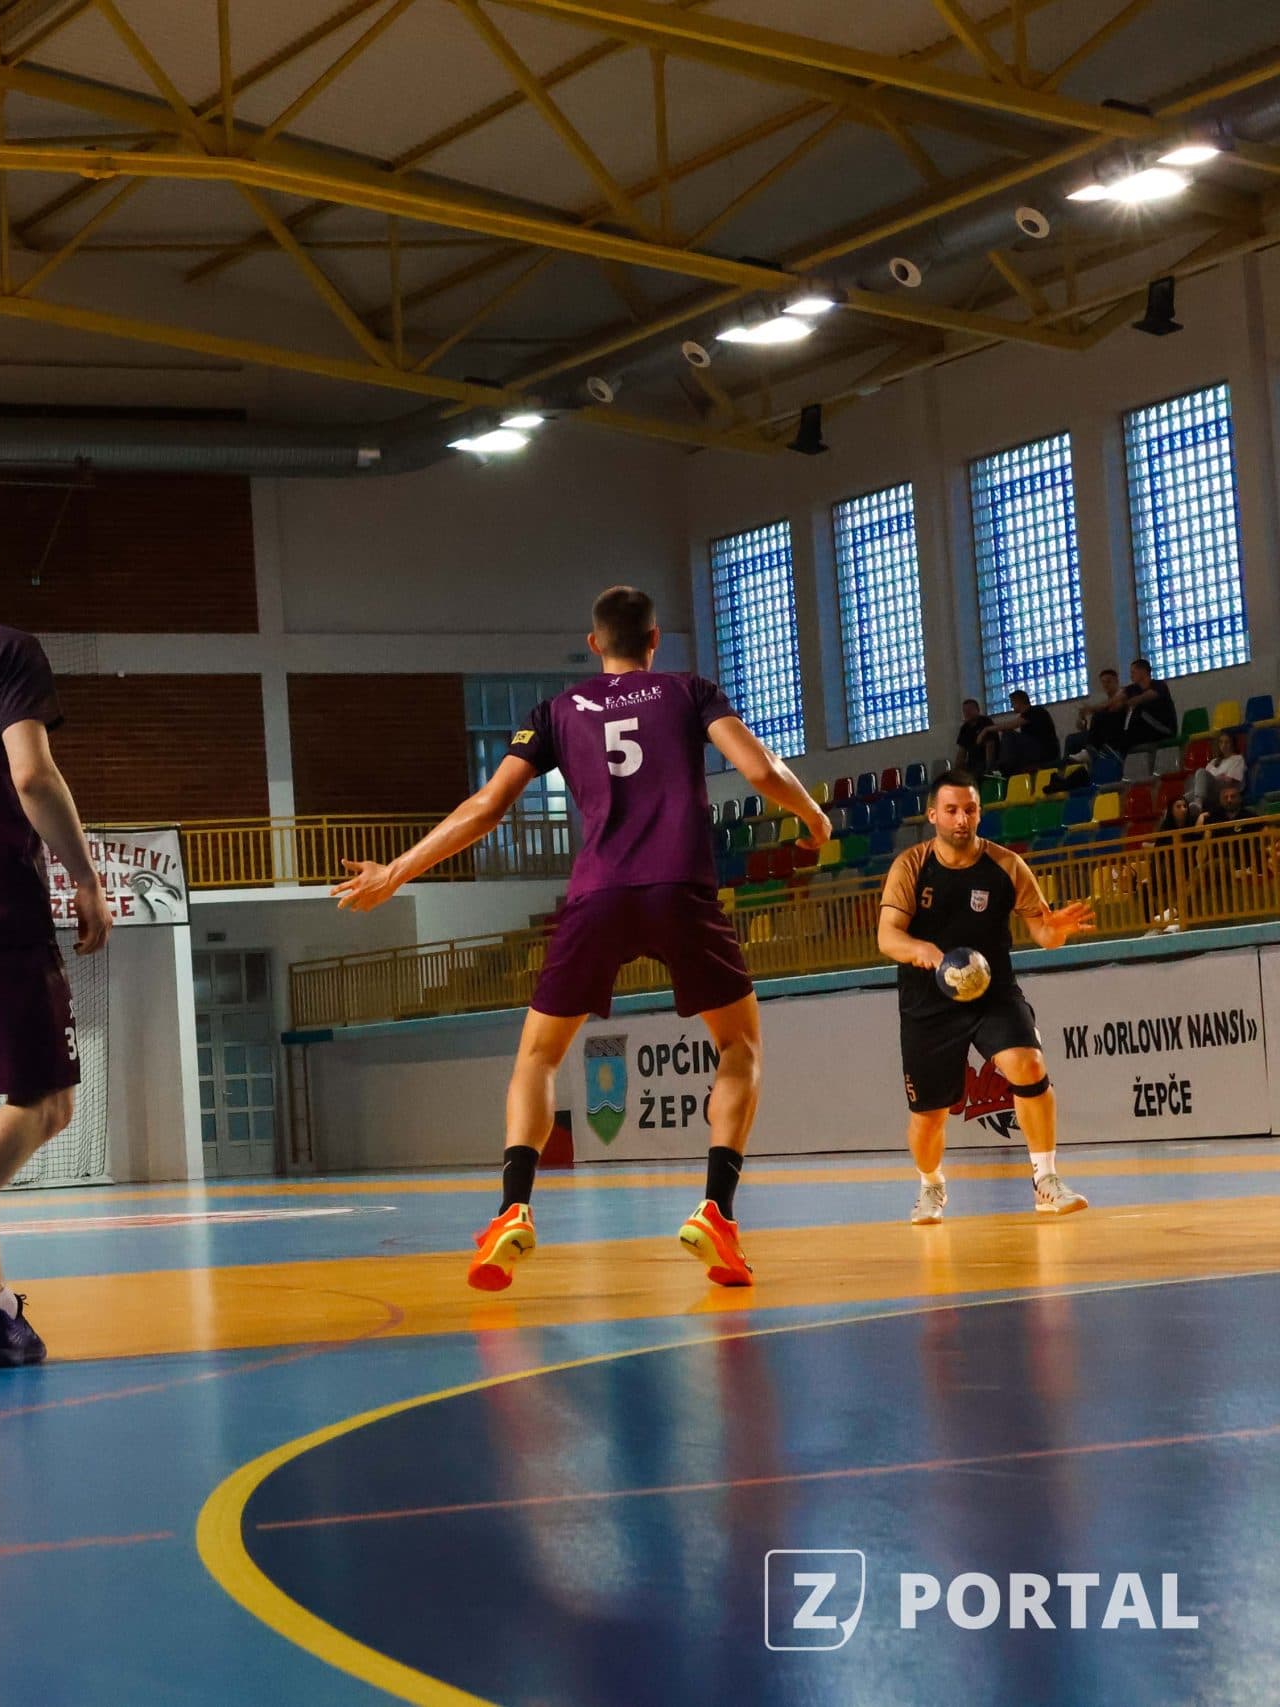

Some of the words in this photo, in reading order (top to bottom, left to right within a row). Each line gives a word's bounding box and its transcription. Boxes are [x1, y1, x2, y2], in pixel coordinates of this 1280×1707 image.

[605, 686, 662, 705] EAGLE
[604, 717, 644, 777] 5
[921, 887, 934, 909] 5
[637, 1034, 720, 1077] OPĆIN
[1063, 1025, 1088, 1059] KK
[1133, 1073, 1192, 1117] ŽEPČE
